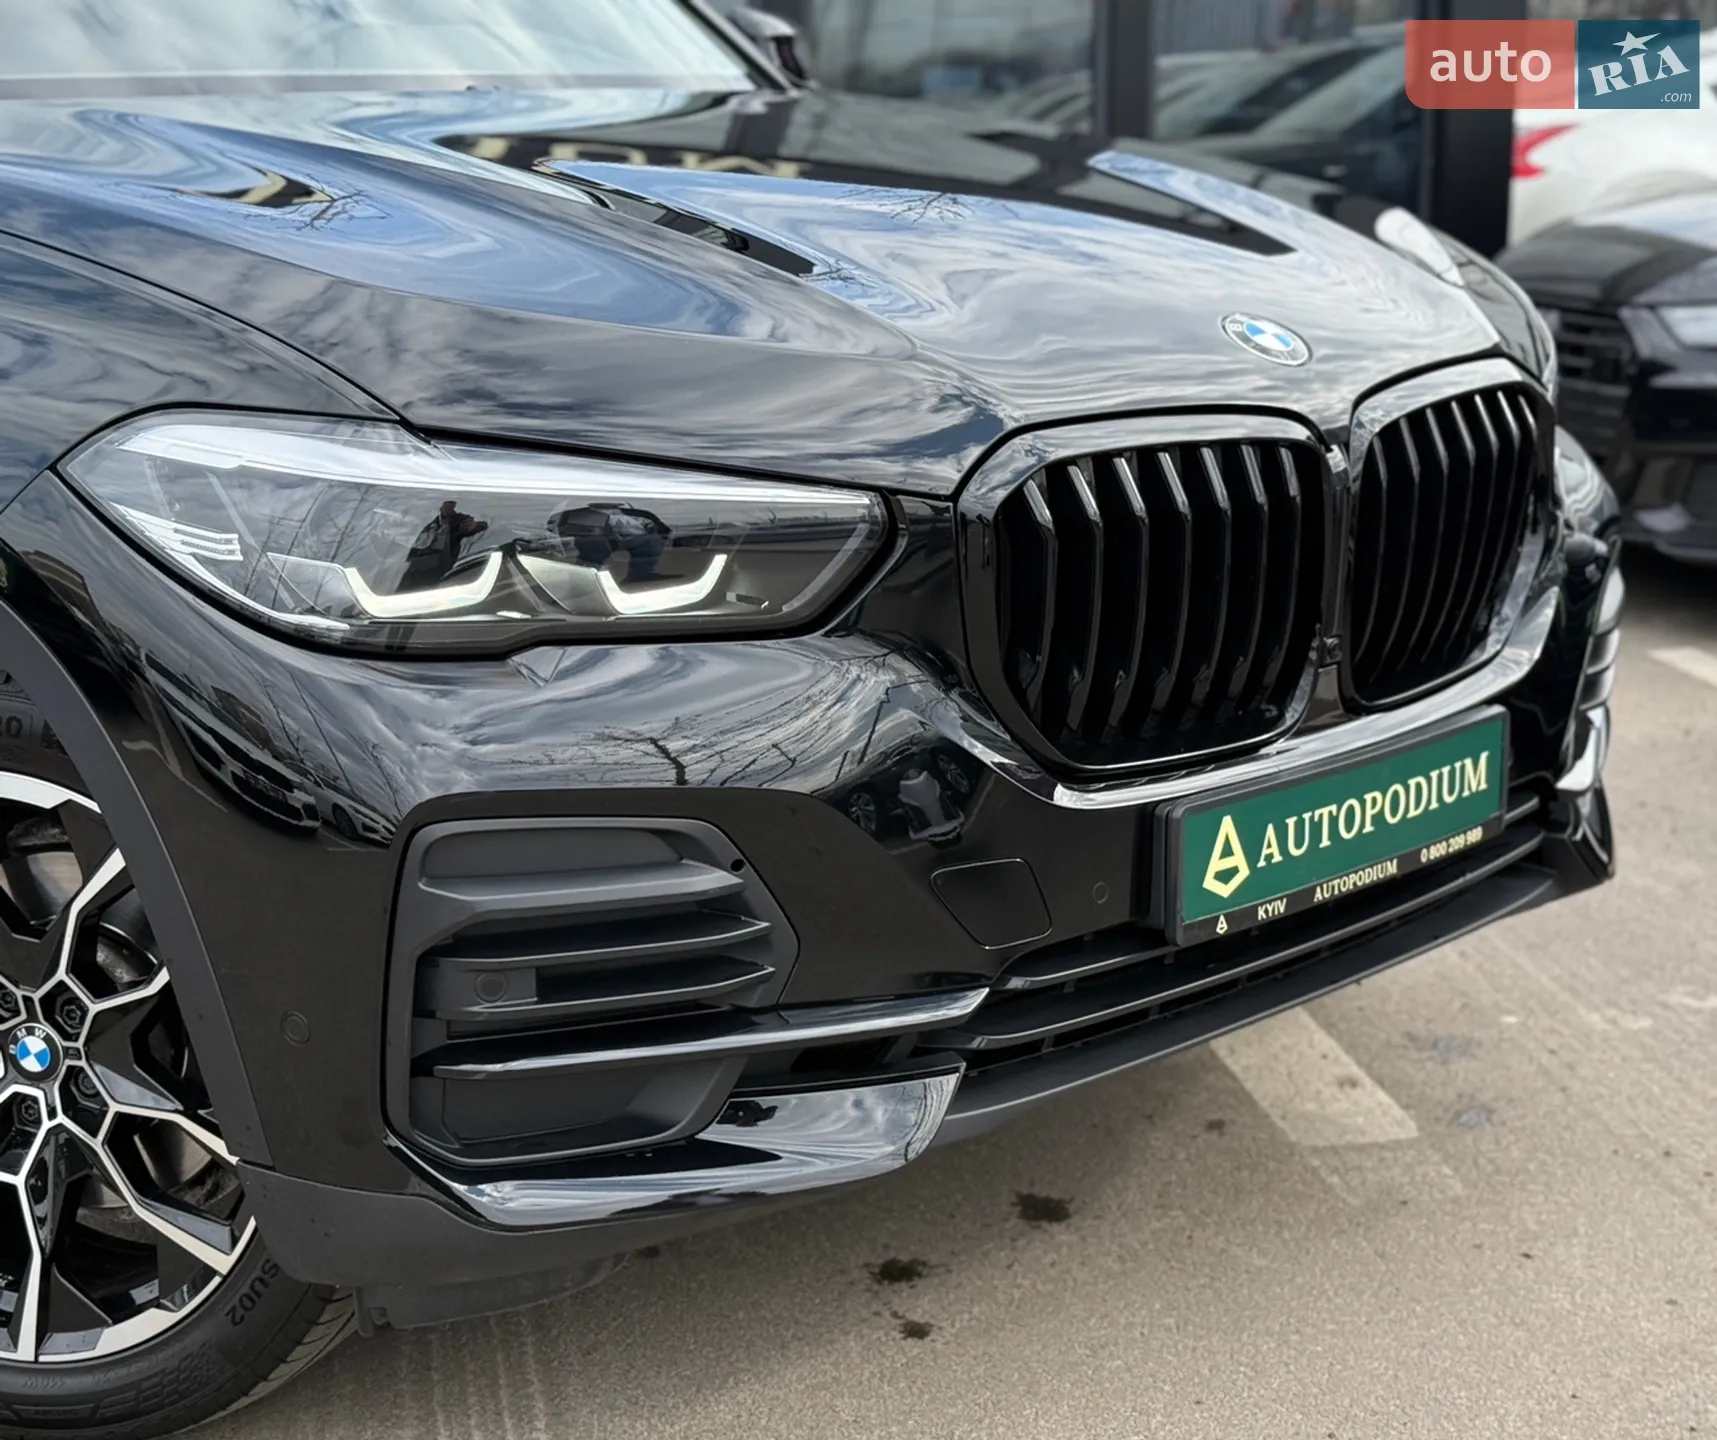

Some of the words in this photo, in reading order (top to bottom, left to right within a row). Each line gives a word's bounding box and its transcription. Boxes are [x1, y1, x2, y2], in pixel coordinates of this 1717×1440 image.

[1256, 750, 1490, 868] AUTOPODIUM
[1257, 898, 1288, 921] KYIV
[1313, 857, 1399, 902] AUTOPODIUM
[9, 1027, 47, 1055] BMW
